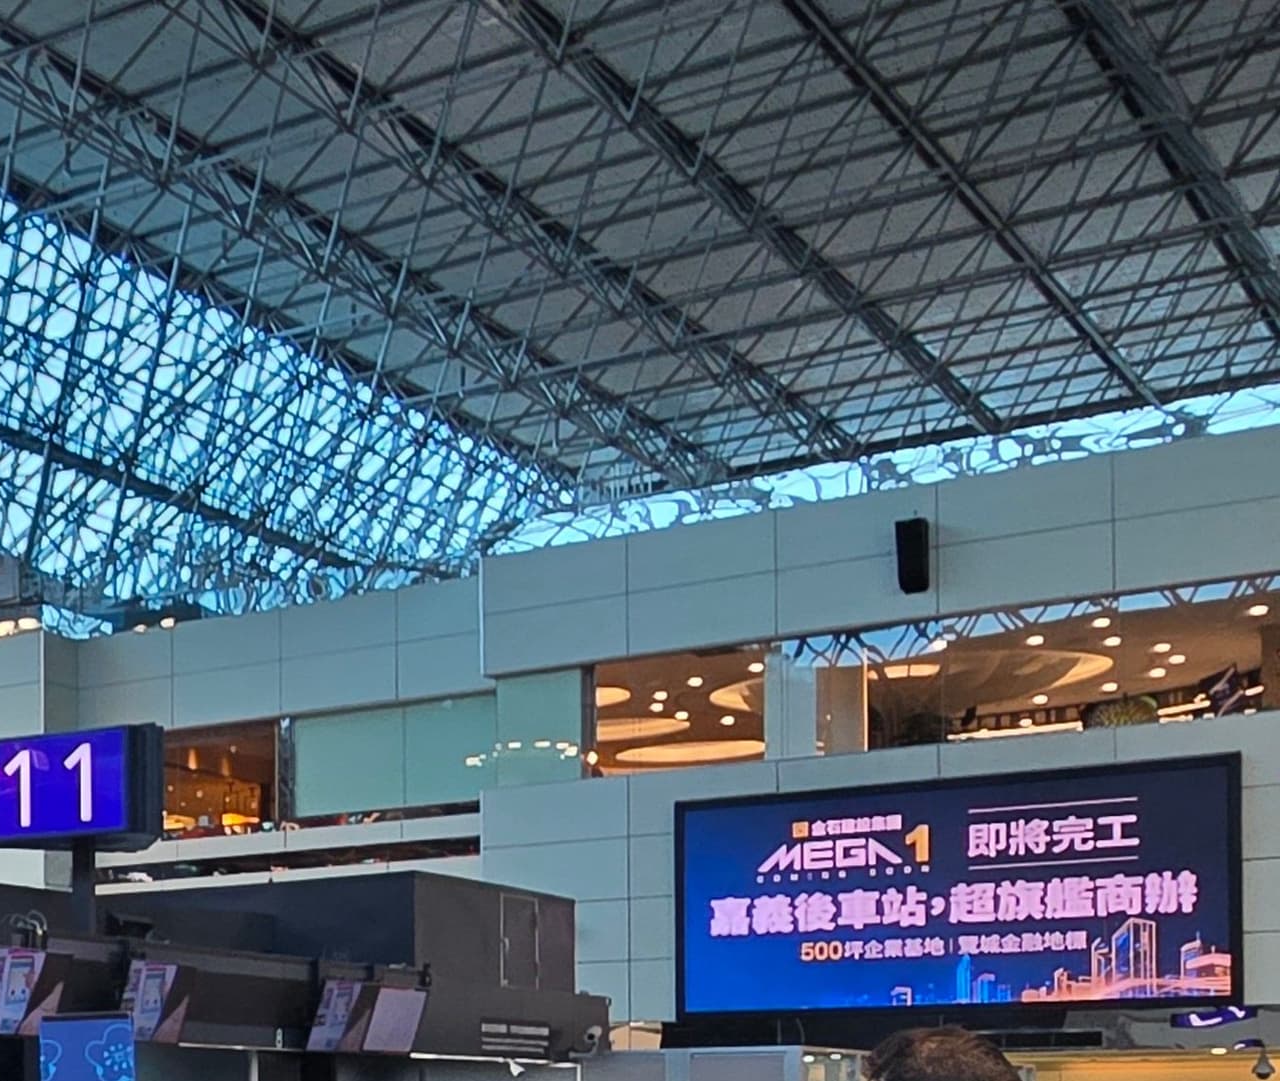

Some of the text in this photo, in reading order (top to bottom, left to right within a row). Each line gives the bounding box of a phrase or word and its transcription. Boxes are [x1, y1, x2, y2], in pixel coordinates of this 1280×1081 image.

[3, 742, 92, 828] 11
[757, 824, 929, 873] MEGA 1
[967, 814, 1139, 858] 即將完工
